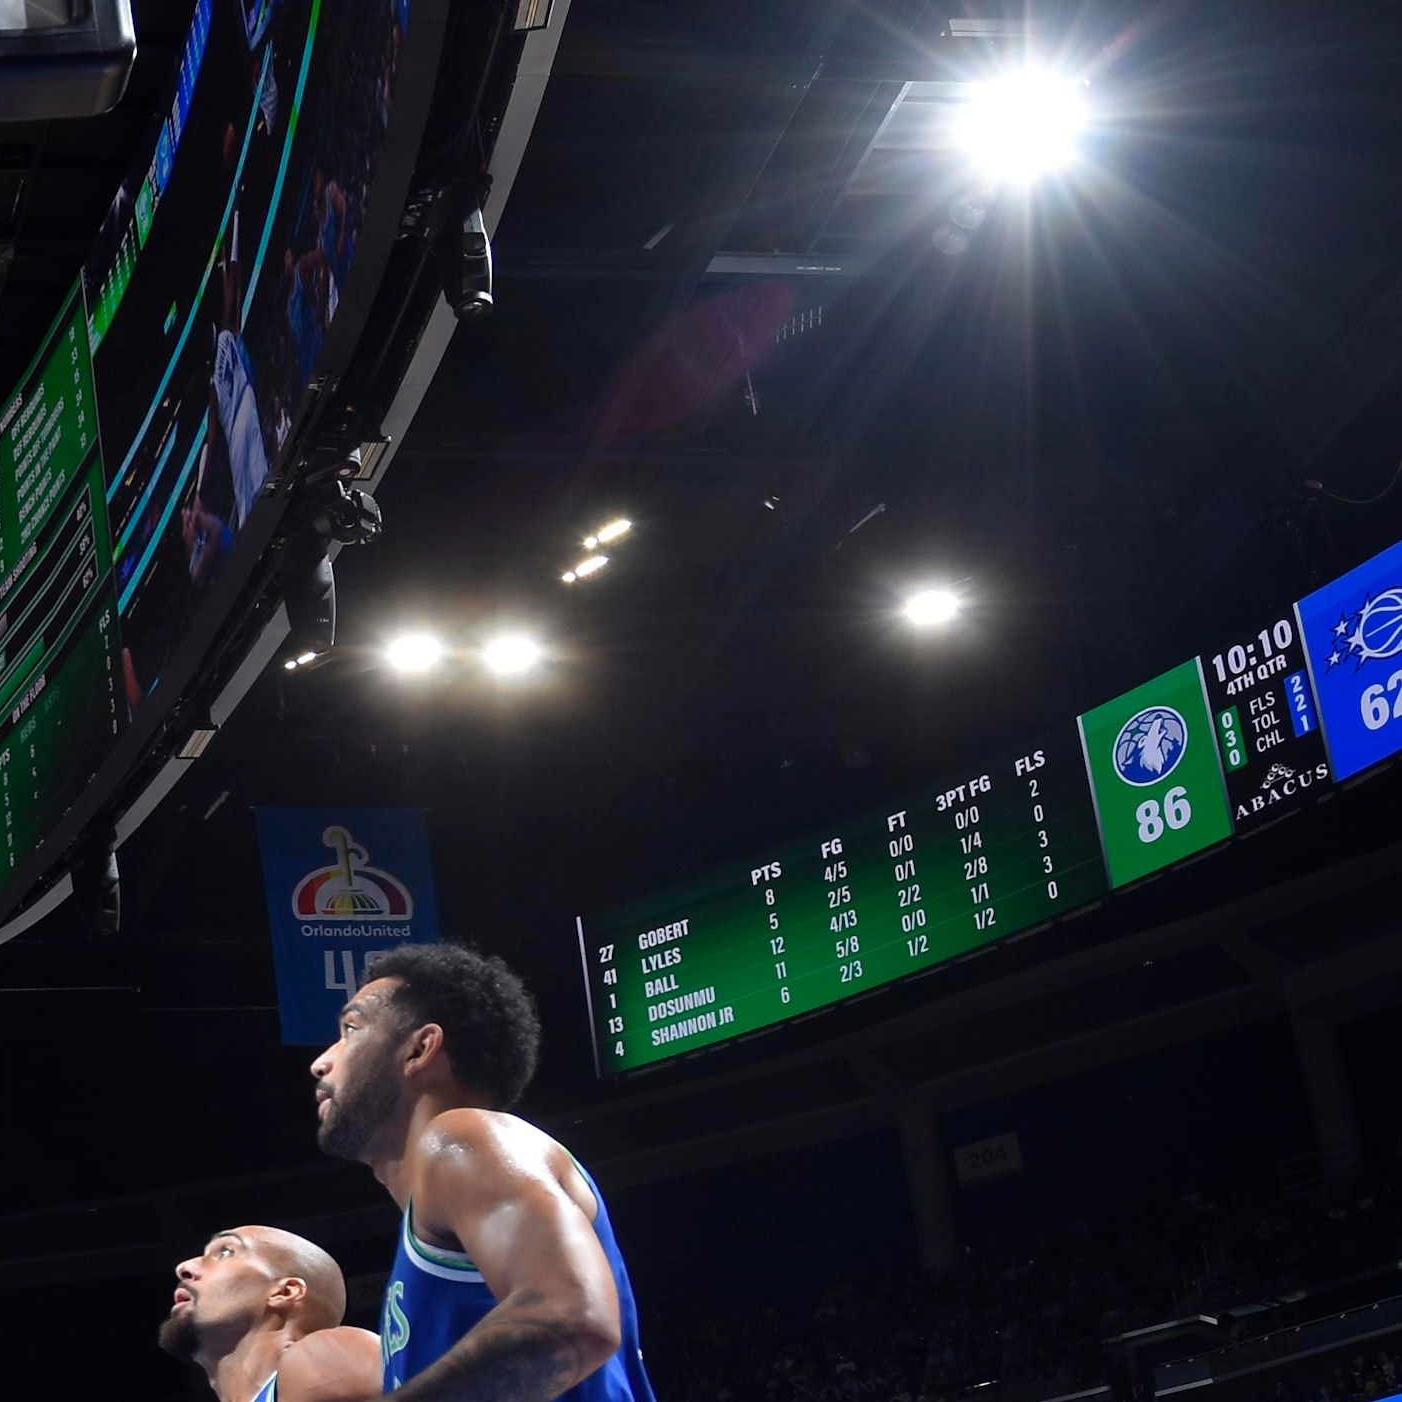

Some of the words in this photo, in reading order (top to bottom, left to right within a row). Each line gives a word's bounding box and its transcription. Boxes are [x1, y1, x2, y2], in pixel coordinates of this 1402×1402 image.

[1211, 619, 1293, 683] 10:10
[1226, 674, 1256, 696] 4TH
[1257, 654, 1288, 680] QTR
[1249, 691, 1276, 716] FLS
[1251, 711, 1280, 733] TOL
[1255, 732, 1286, 753] CHL
[1234, 763, 1330, 821] ABACUS
[750, 861, 782, 886] PTS
[821, 837, 843, 859] FG
[887, 811, 907, 832] FT
[935, 783, 968, 813] 3PT
[968, 774, 992, 798] FG
[1015, 750, 1046, 776] FLS
[1135, 786, 1192, 843] 86
[598, 944, 615, 964] 27
[638, 917, 690, 951] GOBERT
[602, 968, 619, 987] 41
[641, 948, 682, 975] LYLES
[644, 974, 680, 999] BALL
[608, 1016, 624, 1036] 13
[647, 985, 717, 1023] DOSUNMU
[651, 1012, 718, 1047] SHANNON
[718, 1006, 734, 1025] JR
